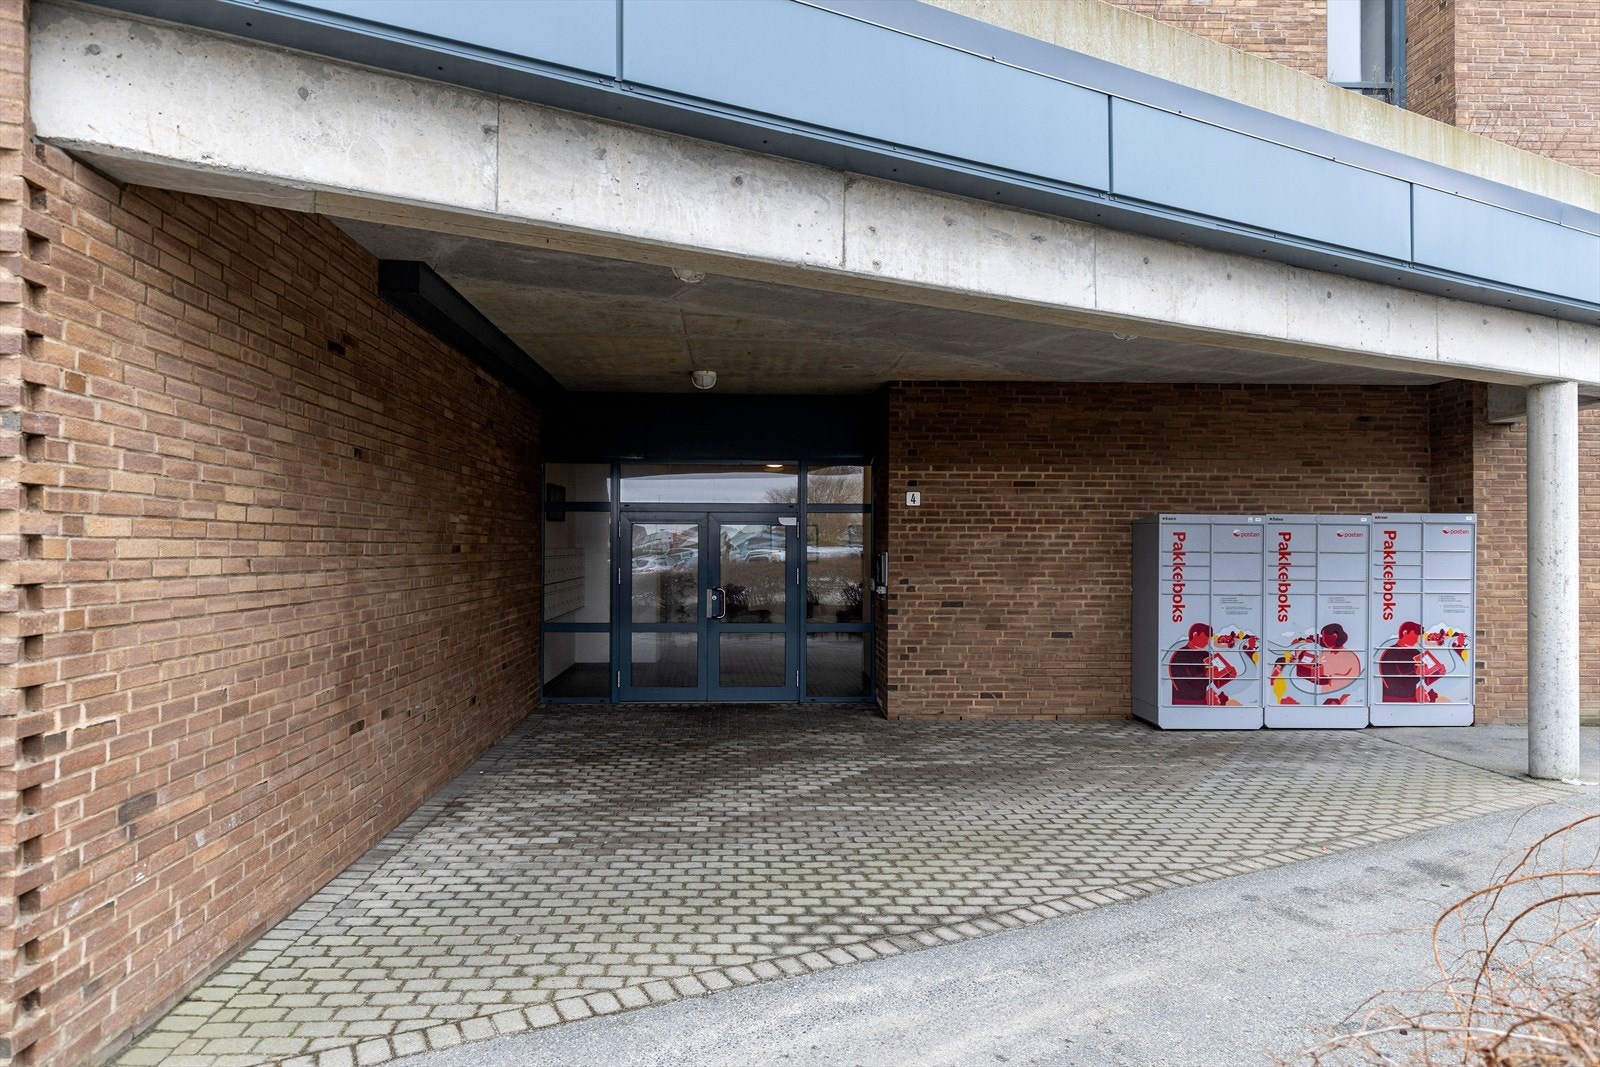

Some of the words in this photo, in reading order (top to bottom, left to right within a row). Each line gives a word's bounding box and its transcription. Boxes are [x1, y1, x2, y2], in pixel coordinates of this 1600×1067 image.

[910, 493, 916, 504] 4
[1172, 531, 1187, 623] Pakkeboks
[1278, 531, 1292, 623] Pakkeboks
[1383, 530, 1397, 621] Pakkeboks
